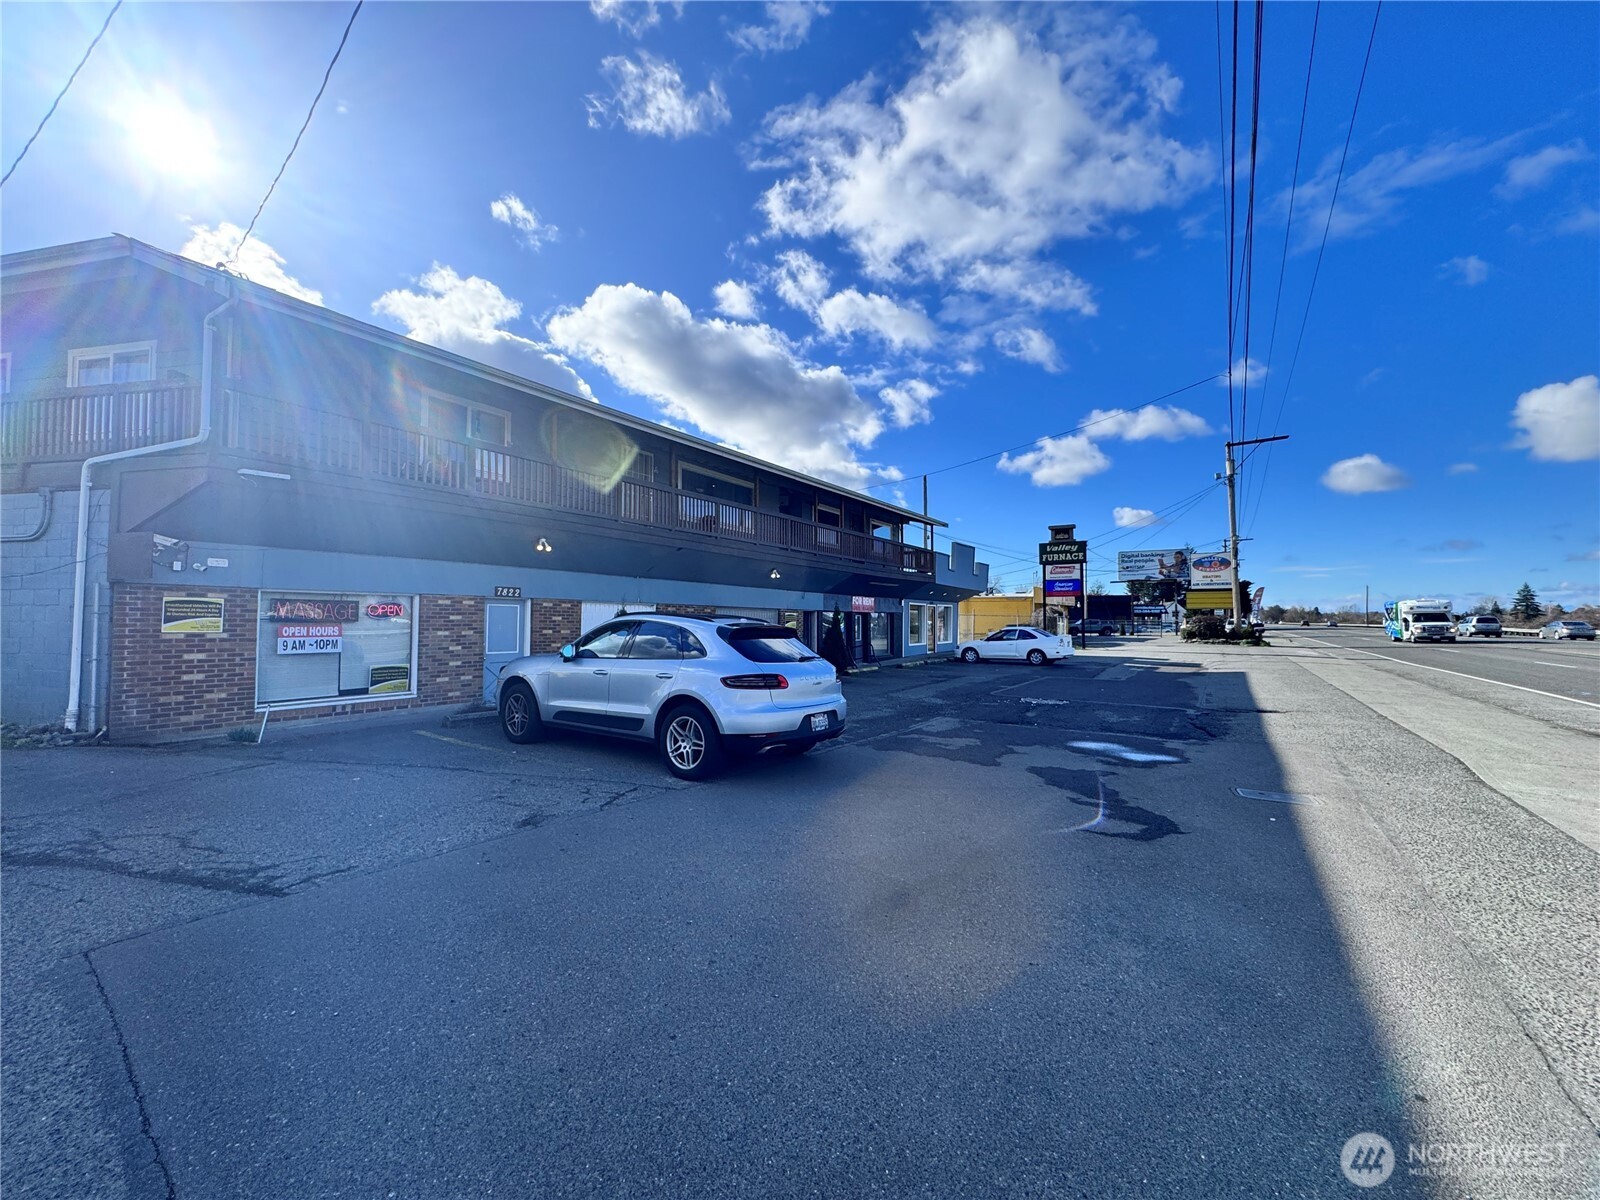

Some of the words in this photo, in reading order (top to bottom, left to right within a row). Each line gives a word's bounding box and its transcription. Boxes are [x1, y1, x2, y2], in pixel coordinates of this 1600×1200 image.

[1046, 544, 1078, 552] Valley
[1042, 552, 1084, 561] FURNACE
[497, 587, 520, 596] 7822
[852, 596, 862, 605] FOR
[862, 596, 875, 606] RENT
[275, 601, 357, 620] MASSAGE
[367, 603, 404, 616] OPEN
[282, 627, 307, 636] OPEN
[309, 626, 339, 636] HOURS
[282, 640, 288, 651] 9
[291, 639, 306, 651] AM
